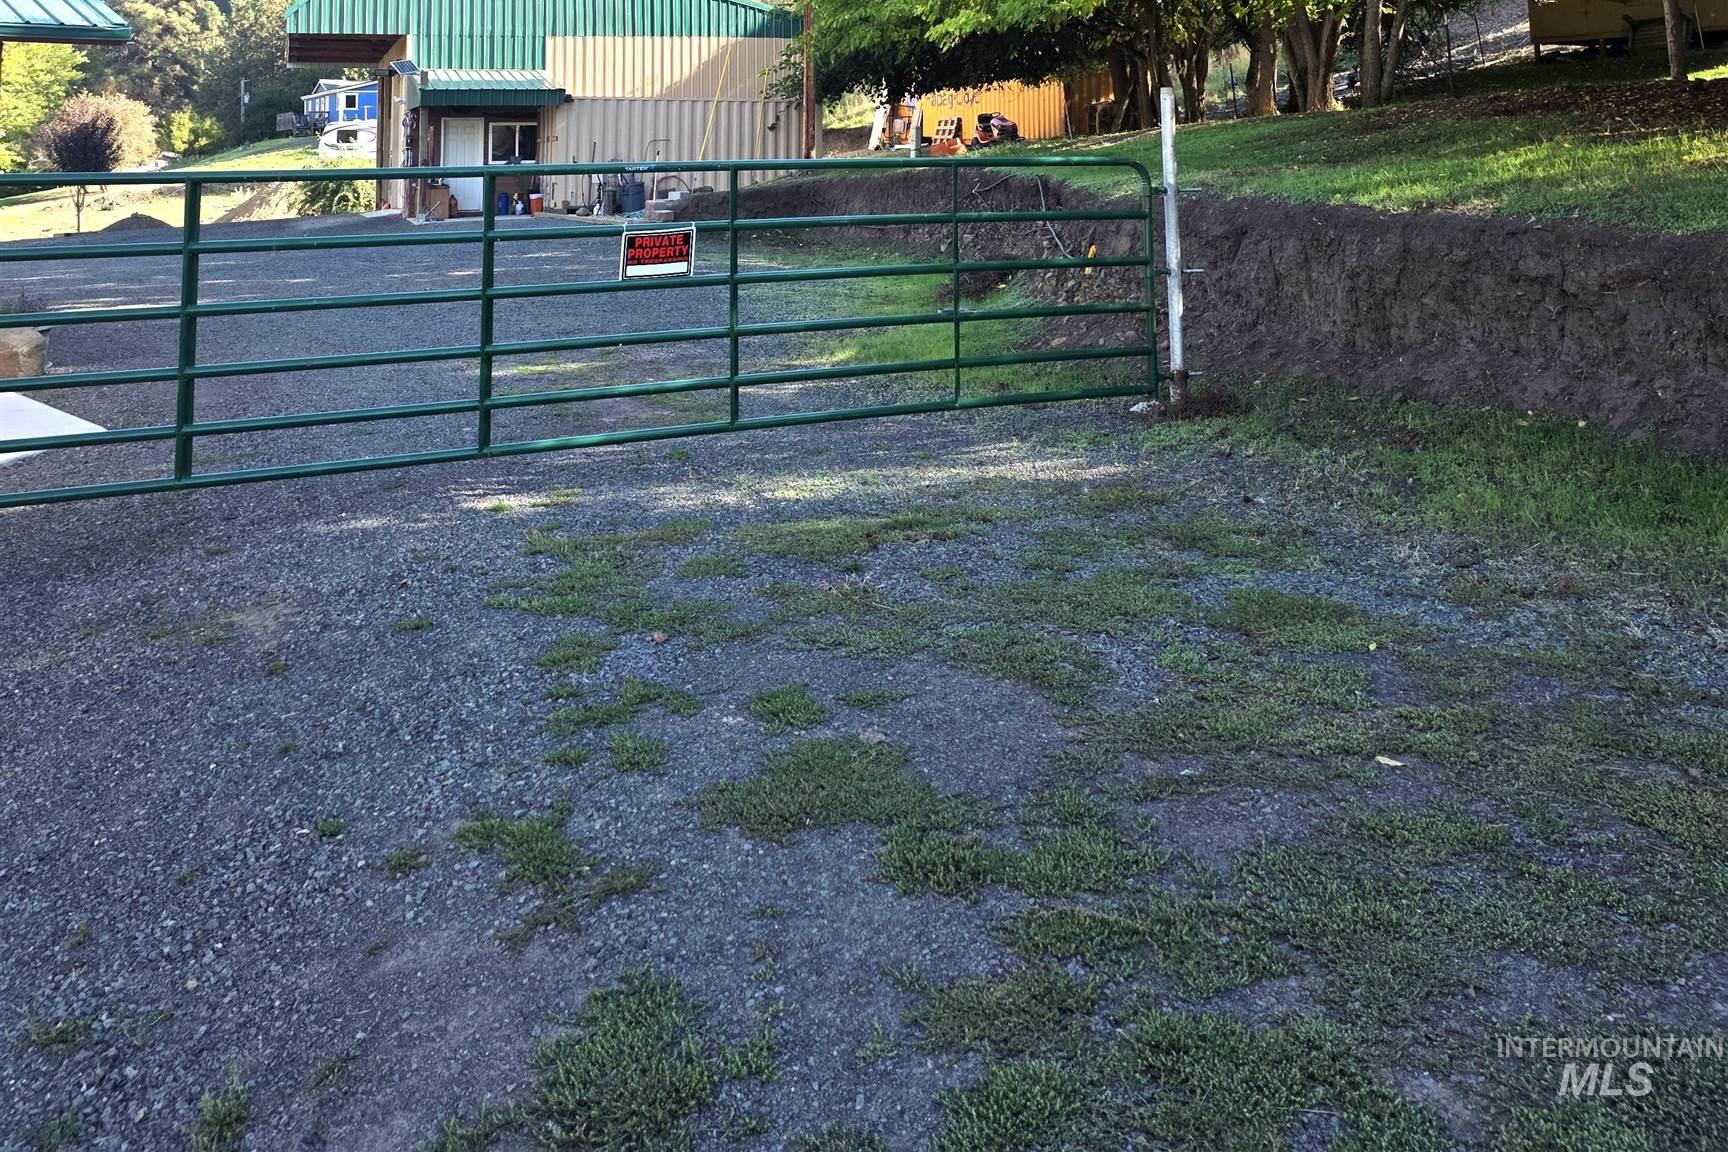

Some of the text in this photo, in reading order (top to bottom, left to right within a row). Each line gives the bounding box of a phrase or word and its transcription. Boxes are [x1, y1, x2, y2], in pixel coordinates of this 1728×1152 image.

[635, 234, 684, 248] PRIVATE
[627, 245, 689, 259] PROPERTY
[640, 256, 689, 264] TRESPASSING
